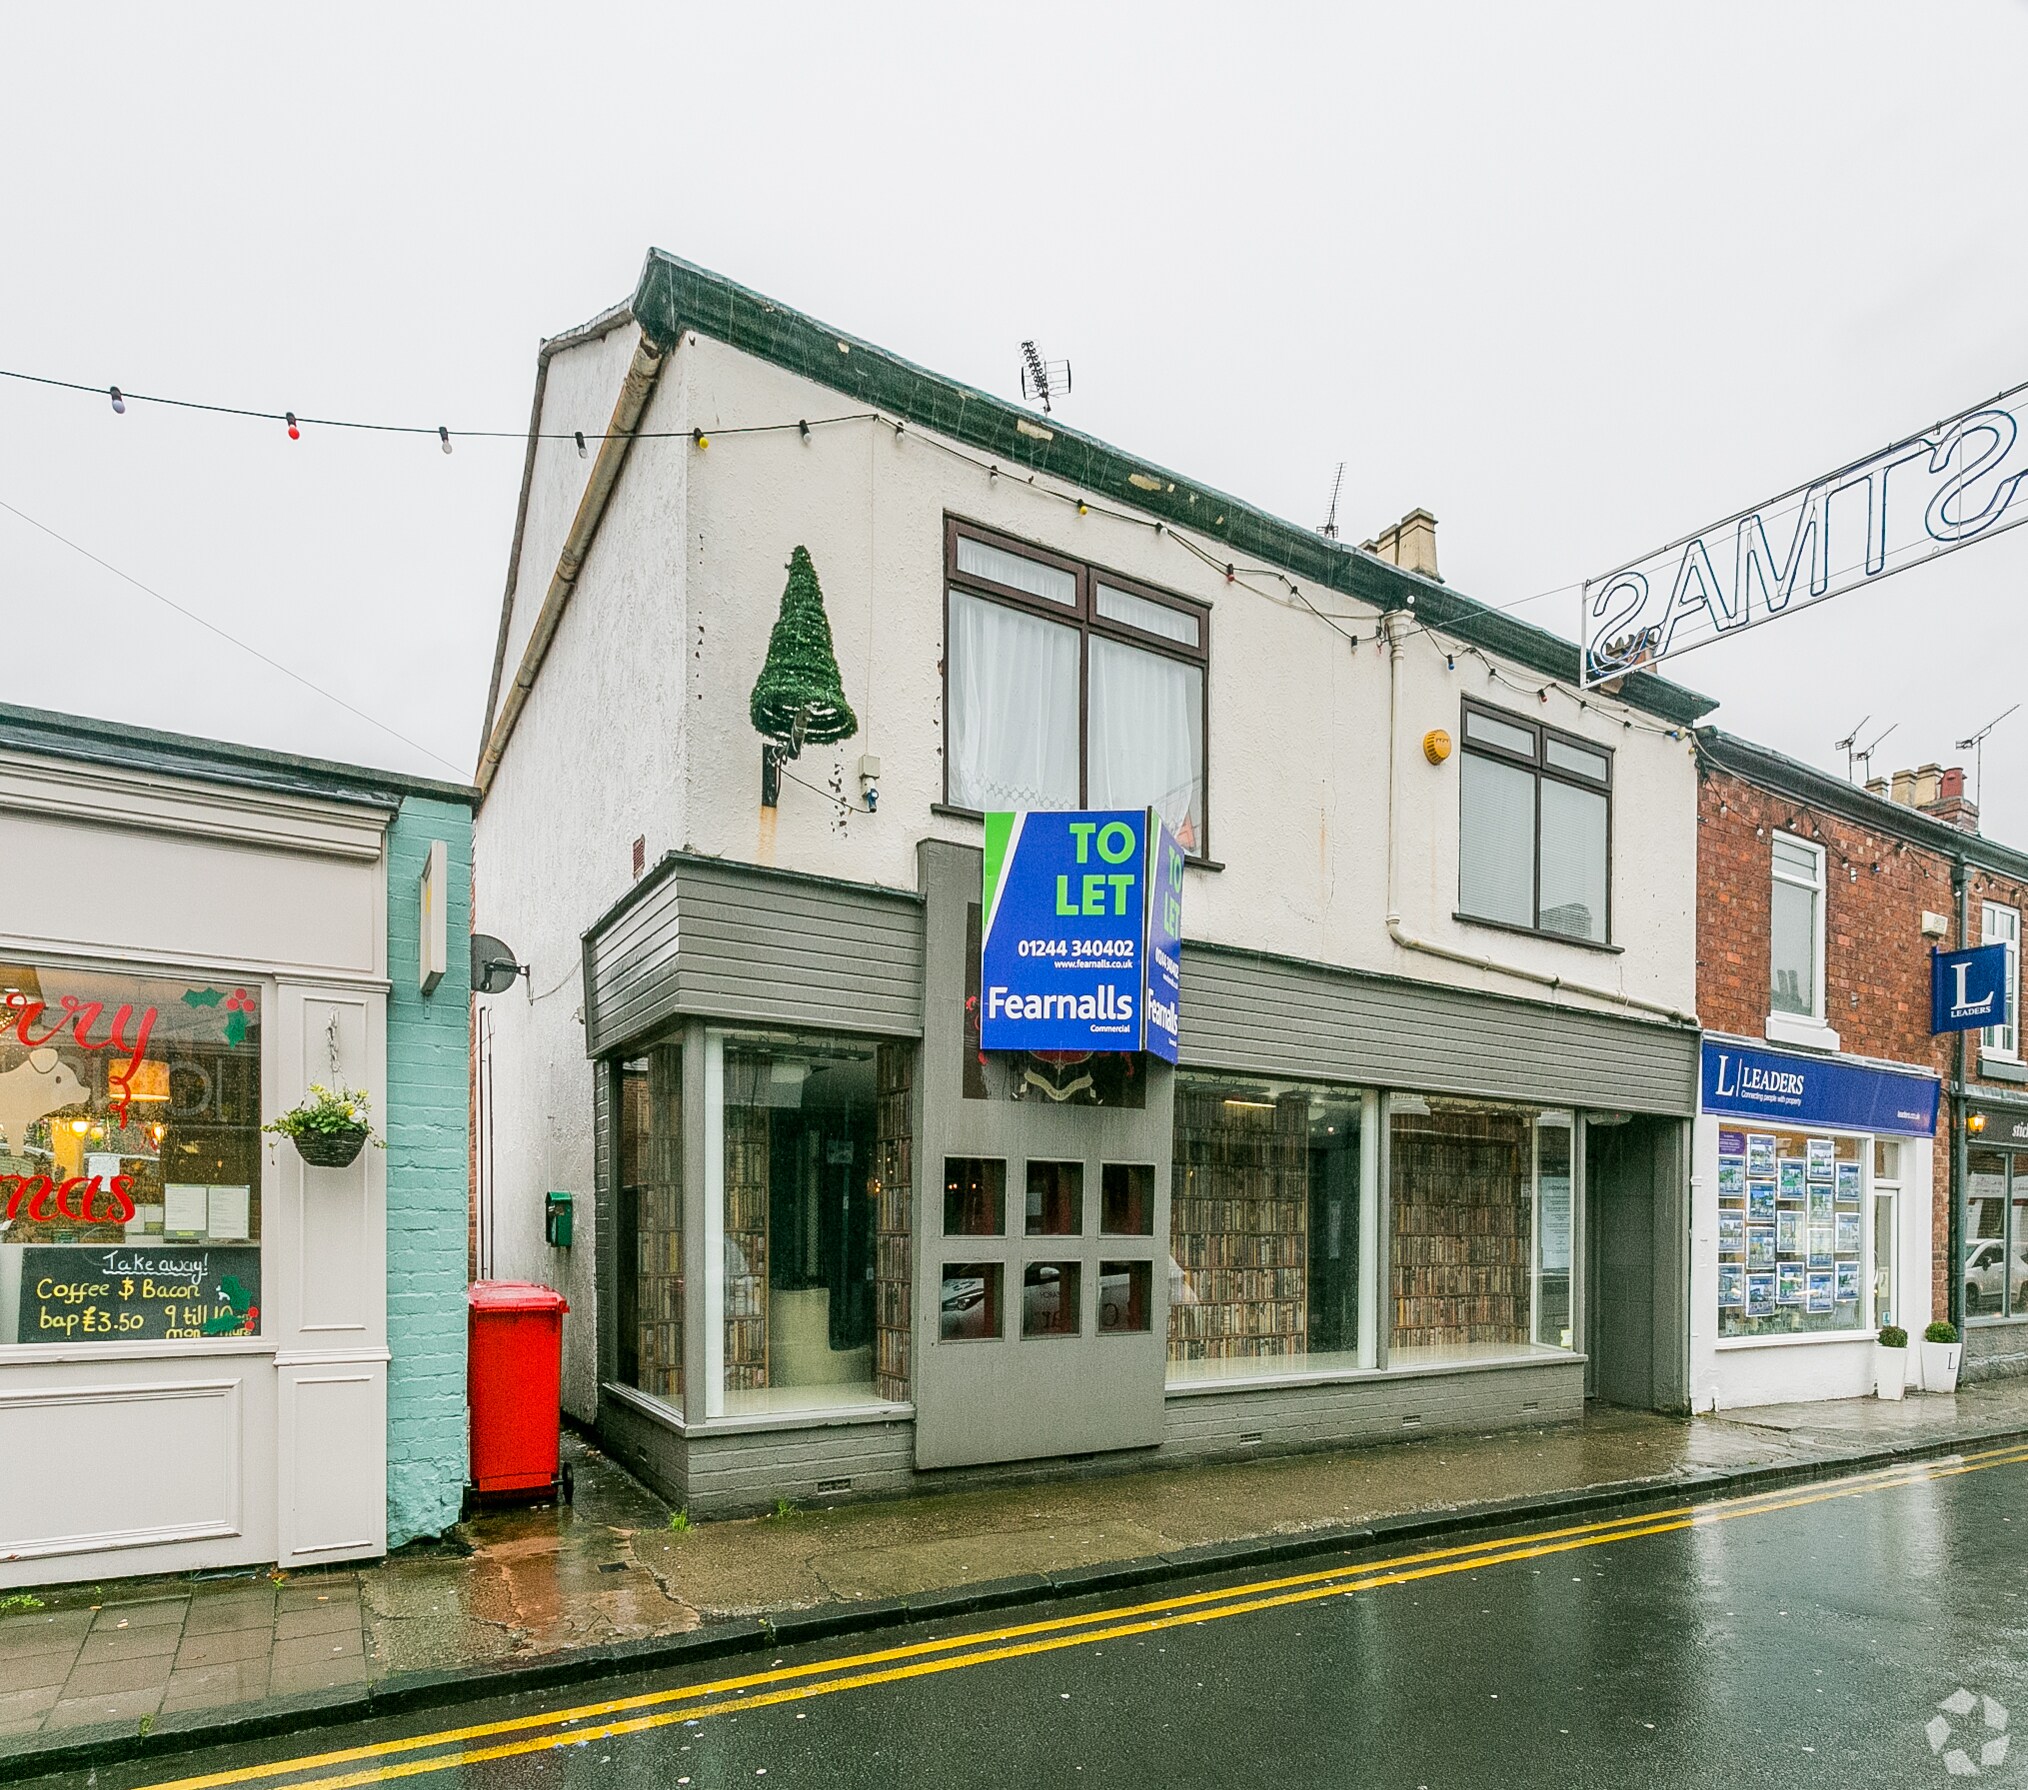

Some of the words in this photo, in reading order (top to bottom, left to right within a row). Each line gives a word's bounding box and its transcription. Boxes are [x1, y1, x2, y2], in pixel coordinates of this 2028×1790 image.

[1069, 821, 1136, 865] TO
[1168, 845, 1182, 893] TO
[1056, 874, 1135, 916] LET
[1163, 890, 1180, 942] LET
[1018, 939, 1067, 957] 01244
[1071, 939, 1134, 957] 340402
[1054, 958, 1133, 970] www.fearnalls.co.uk
[988, 984, 1133, 1020] Fearnalls
[1950, 961, 1995, 1010] L
[1089, 1024, 1131, 1033] Commercial
[1148, 987, 1178, 1036] Fearnalls
[1950, 1005, 1992, 1018] LEADERS
[0, 992, 158, 1130] rry
[1715, 1054, 1735, 1097] L
[1742, 1067, 1805, 1095] LEADERS
[36, 1278, 110, 1304] Coffee
[143, 1278, 200, 1299] Bacon
[39, 1306, 80, 1336] bap
[164, 1304, 176, 1328] 9
[183, 1304, 207, 1325] till
[1947, 1351, 1957, 1370] L
